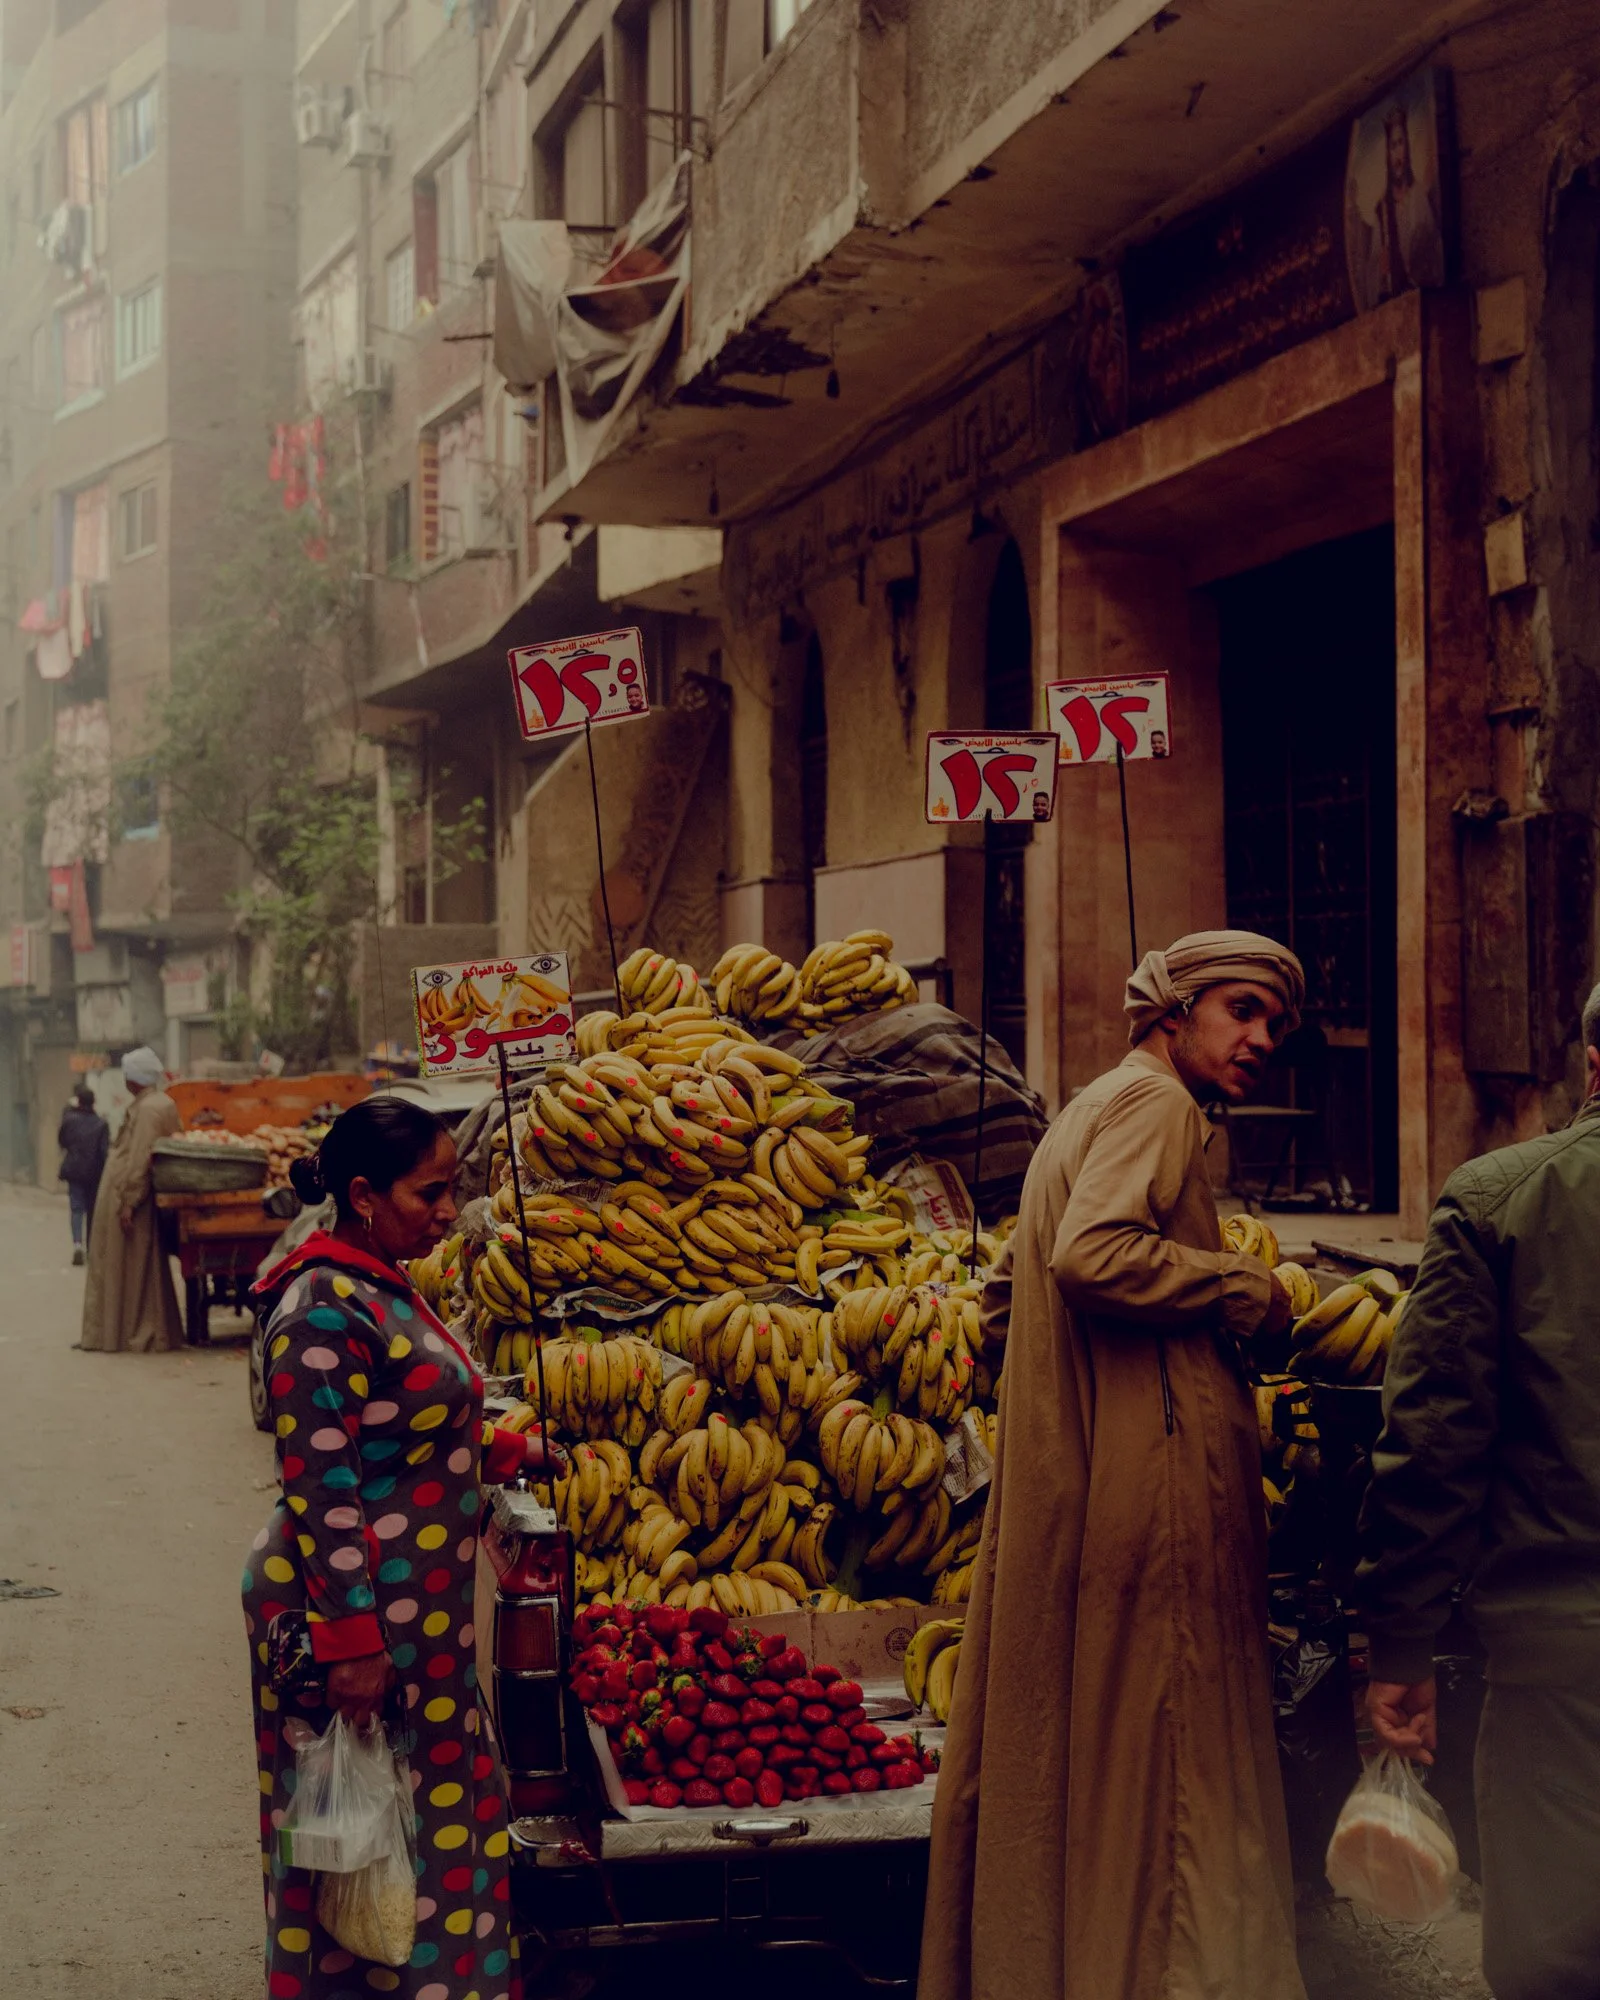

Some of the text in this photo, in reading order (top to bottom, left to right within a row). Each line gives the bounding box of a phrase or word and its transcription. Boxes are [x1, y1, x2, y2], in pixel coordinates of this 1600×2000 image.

[579, 637, 605, 649] ياسين
[1109, 681, 1134, 691] ياسين
[995, 738, 1022, 747] ياسين
[496, 961, 518, 974] ملكة
[426, 1013, 571, 1064] موز
